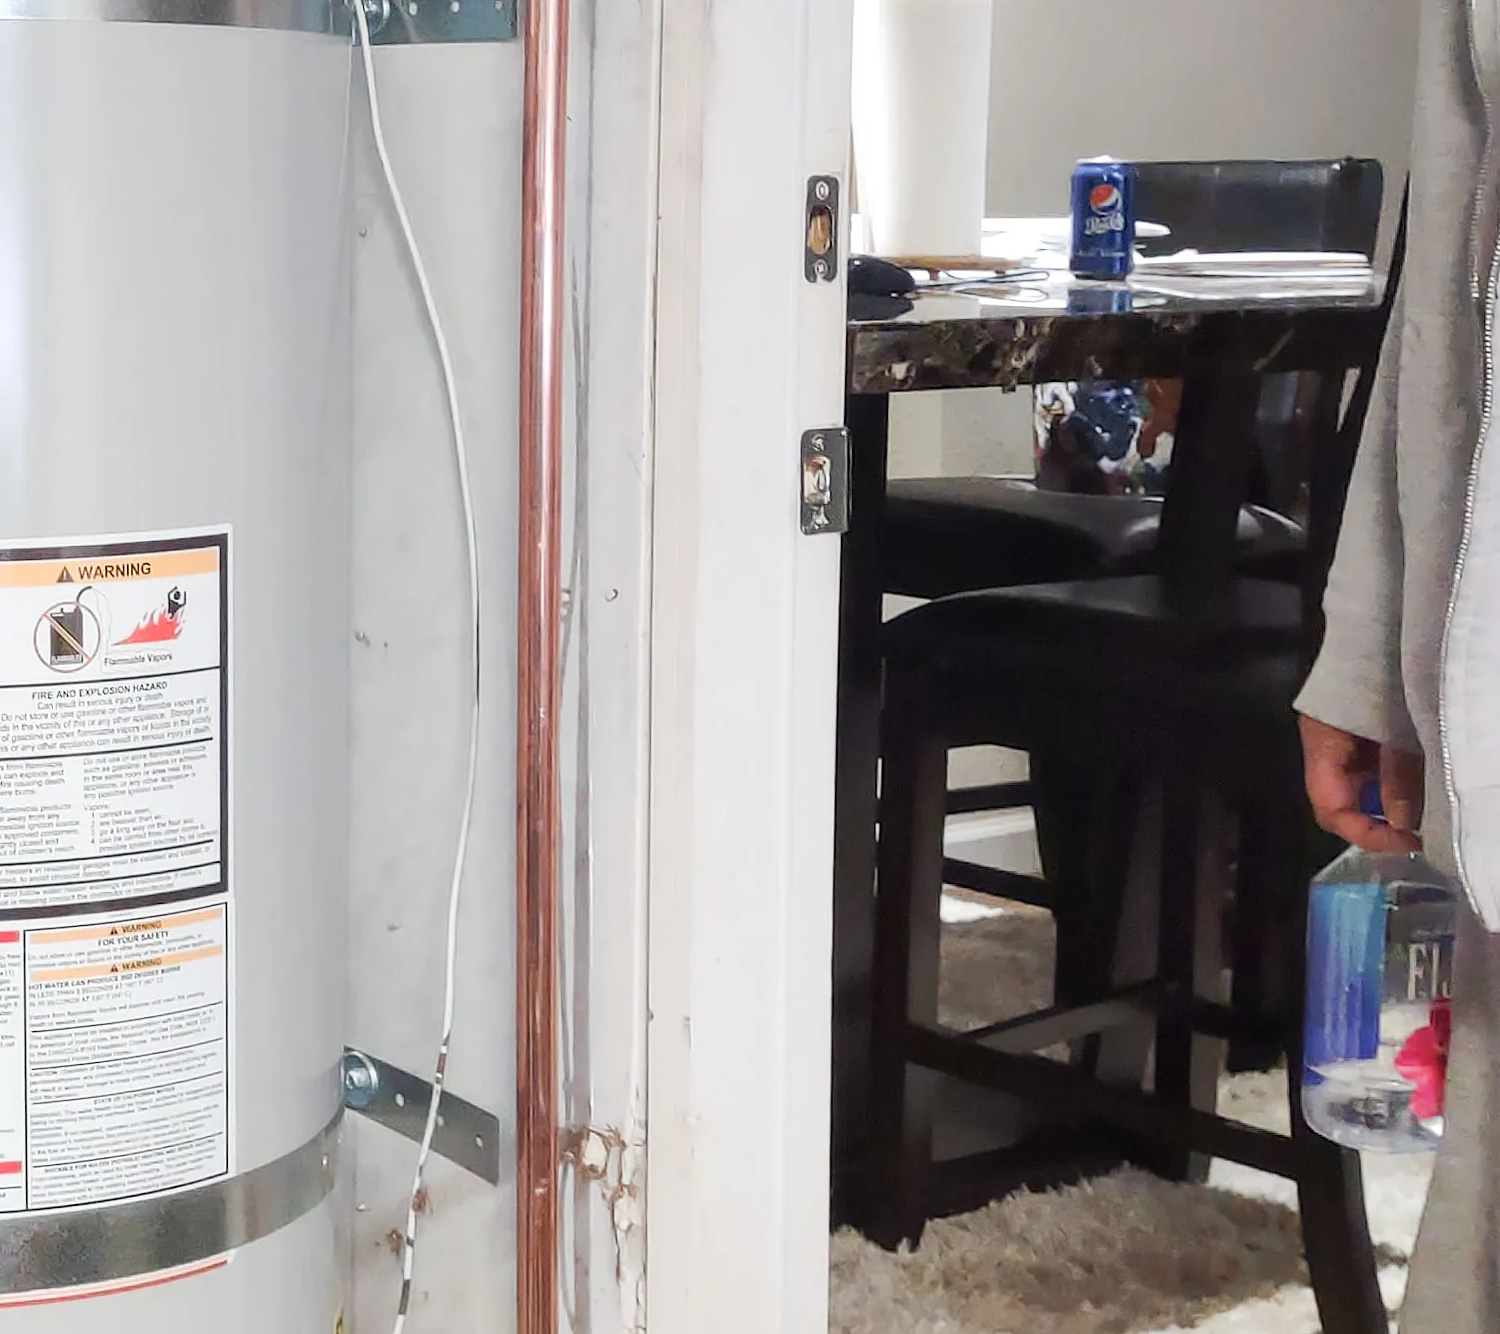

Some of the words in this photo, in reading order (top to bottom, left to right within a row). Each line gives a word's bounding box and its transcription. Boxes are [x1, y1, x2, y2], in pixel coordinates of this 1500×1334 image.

[78, 561, 152, 580] WARNING
[31, 690, 54, 700] FIRE
[56, 688, 77, 699] AND
[79, 684, 132, 698] EXPLOSION
[132, 680, 169, 693] HAZARD
[121, 920, 162, 934] WARNING
[97, 937, 116, 948] FOR
[116, 934, 140, 946] YOUR
[140, 930, 170, 942] SAFETY
[122, 957, 163, 971] WARNING
[28, 982, 44, 992] HOT
[44, 979, 70, 990] WATER
